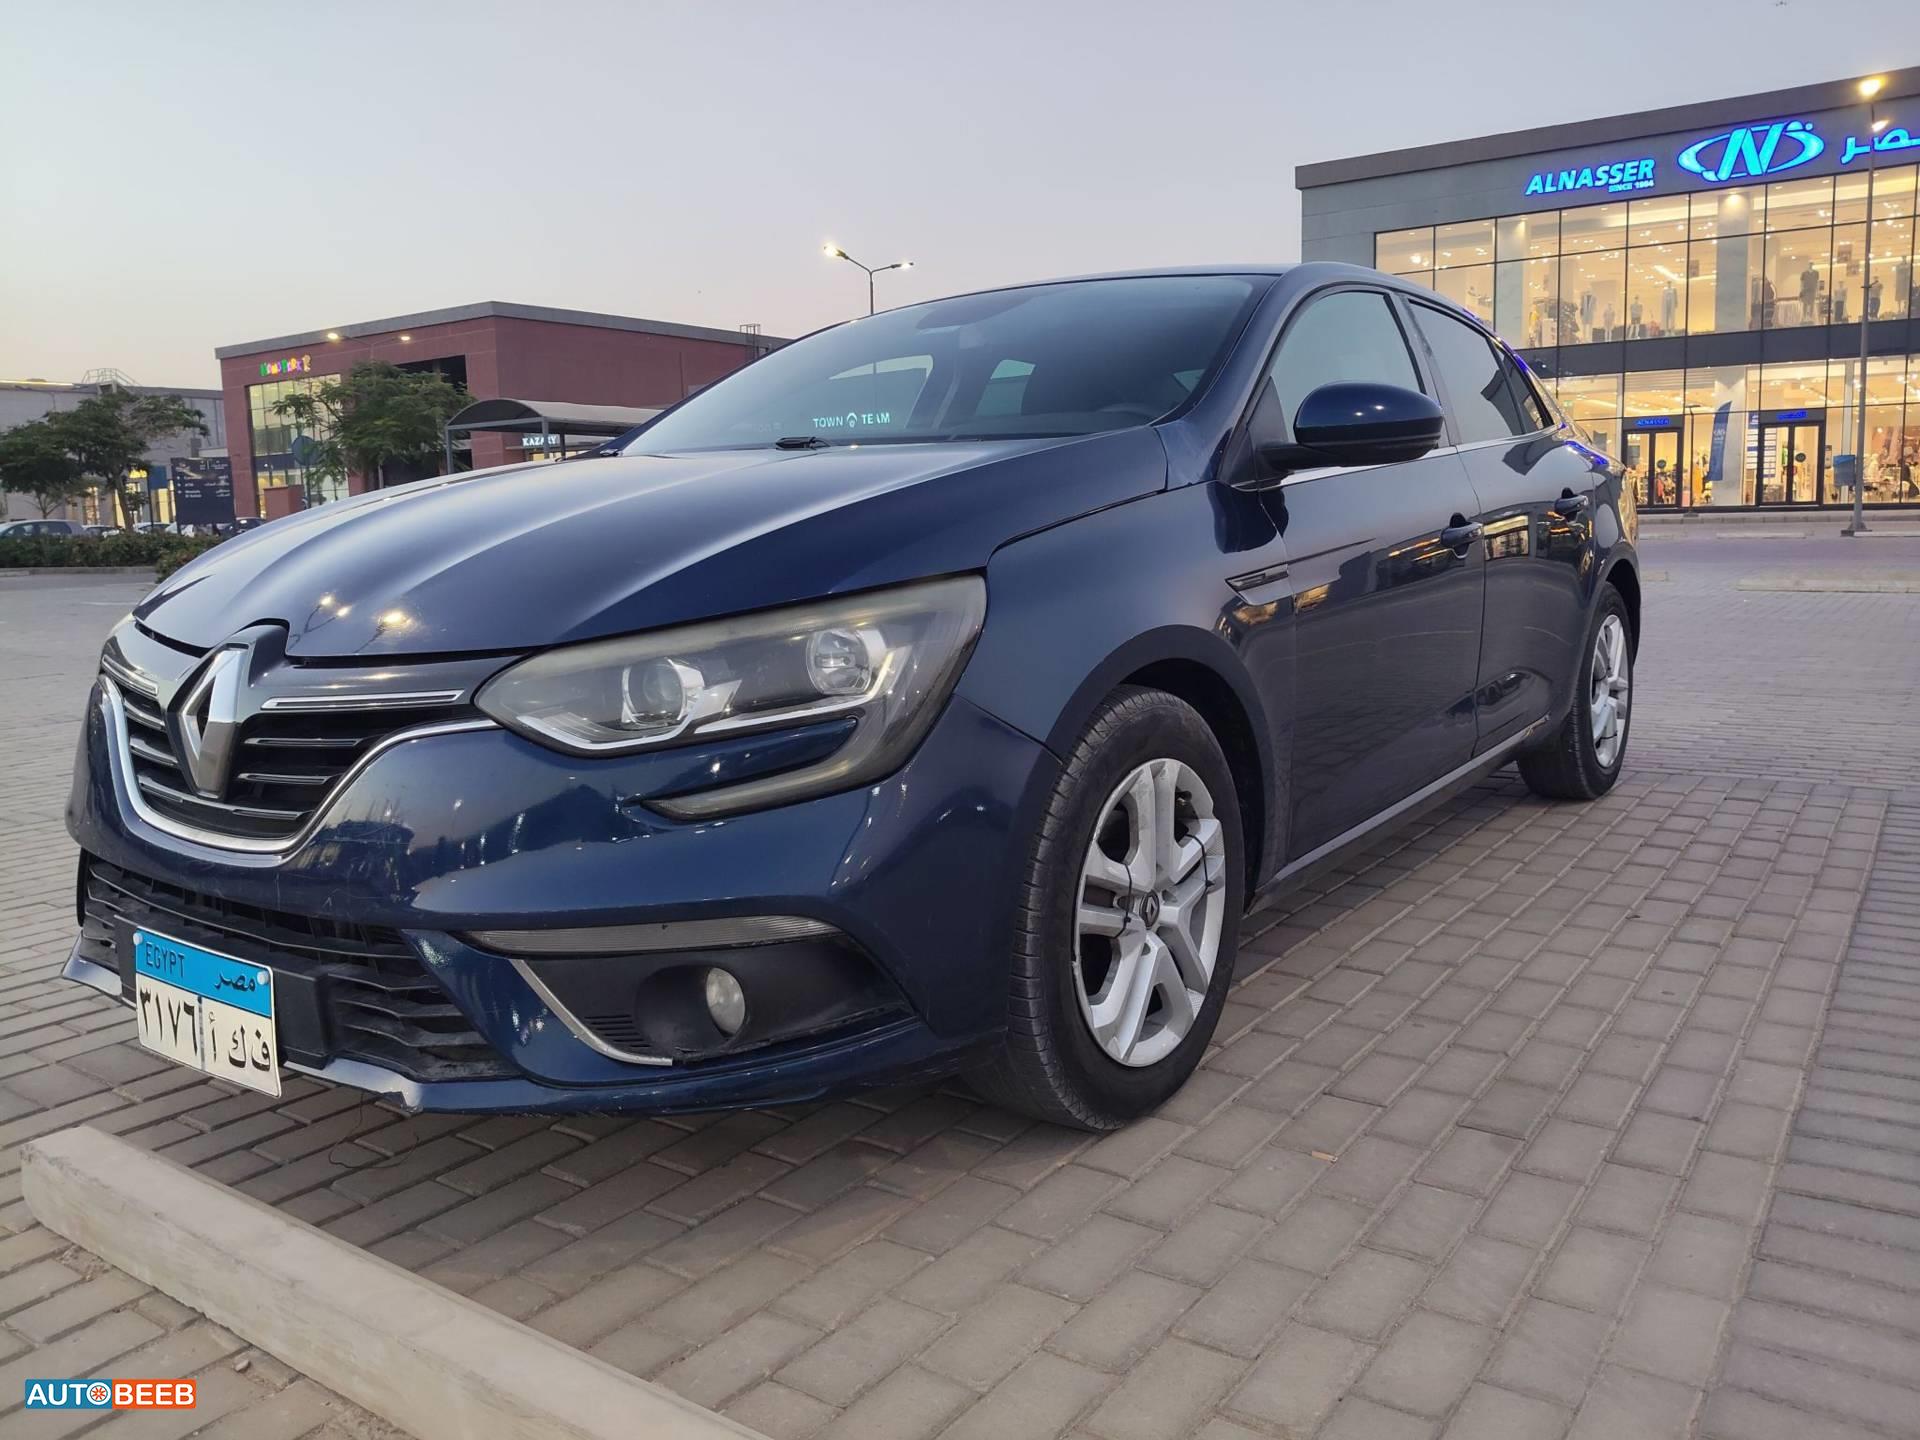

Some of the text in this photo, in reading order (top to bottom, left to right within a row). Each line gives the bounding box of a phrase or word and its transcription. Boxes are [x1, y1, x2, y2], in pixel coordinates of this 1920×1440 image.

[1525, 159, 1655, 195] ALNASSER
[1608, 182, 1633, 193] SINCE
[813, 416, 843, 428] TOWN
[145, 942, 185, 977] EGYPT
[214, 970, 256, 992] مصر
[139, 987, 199, 1057] ٣١٧٦
